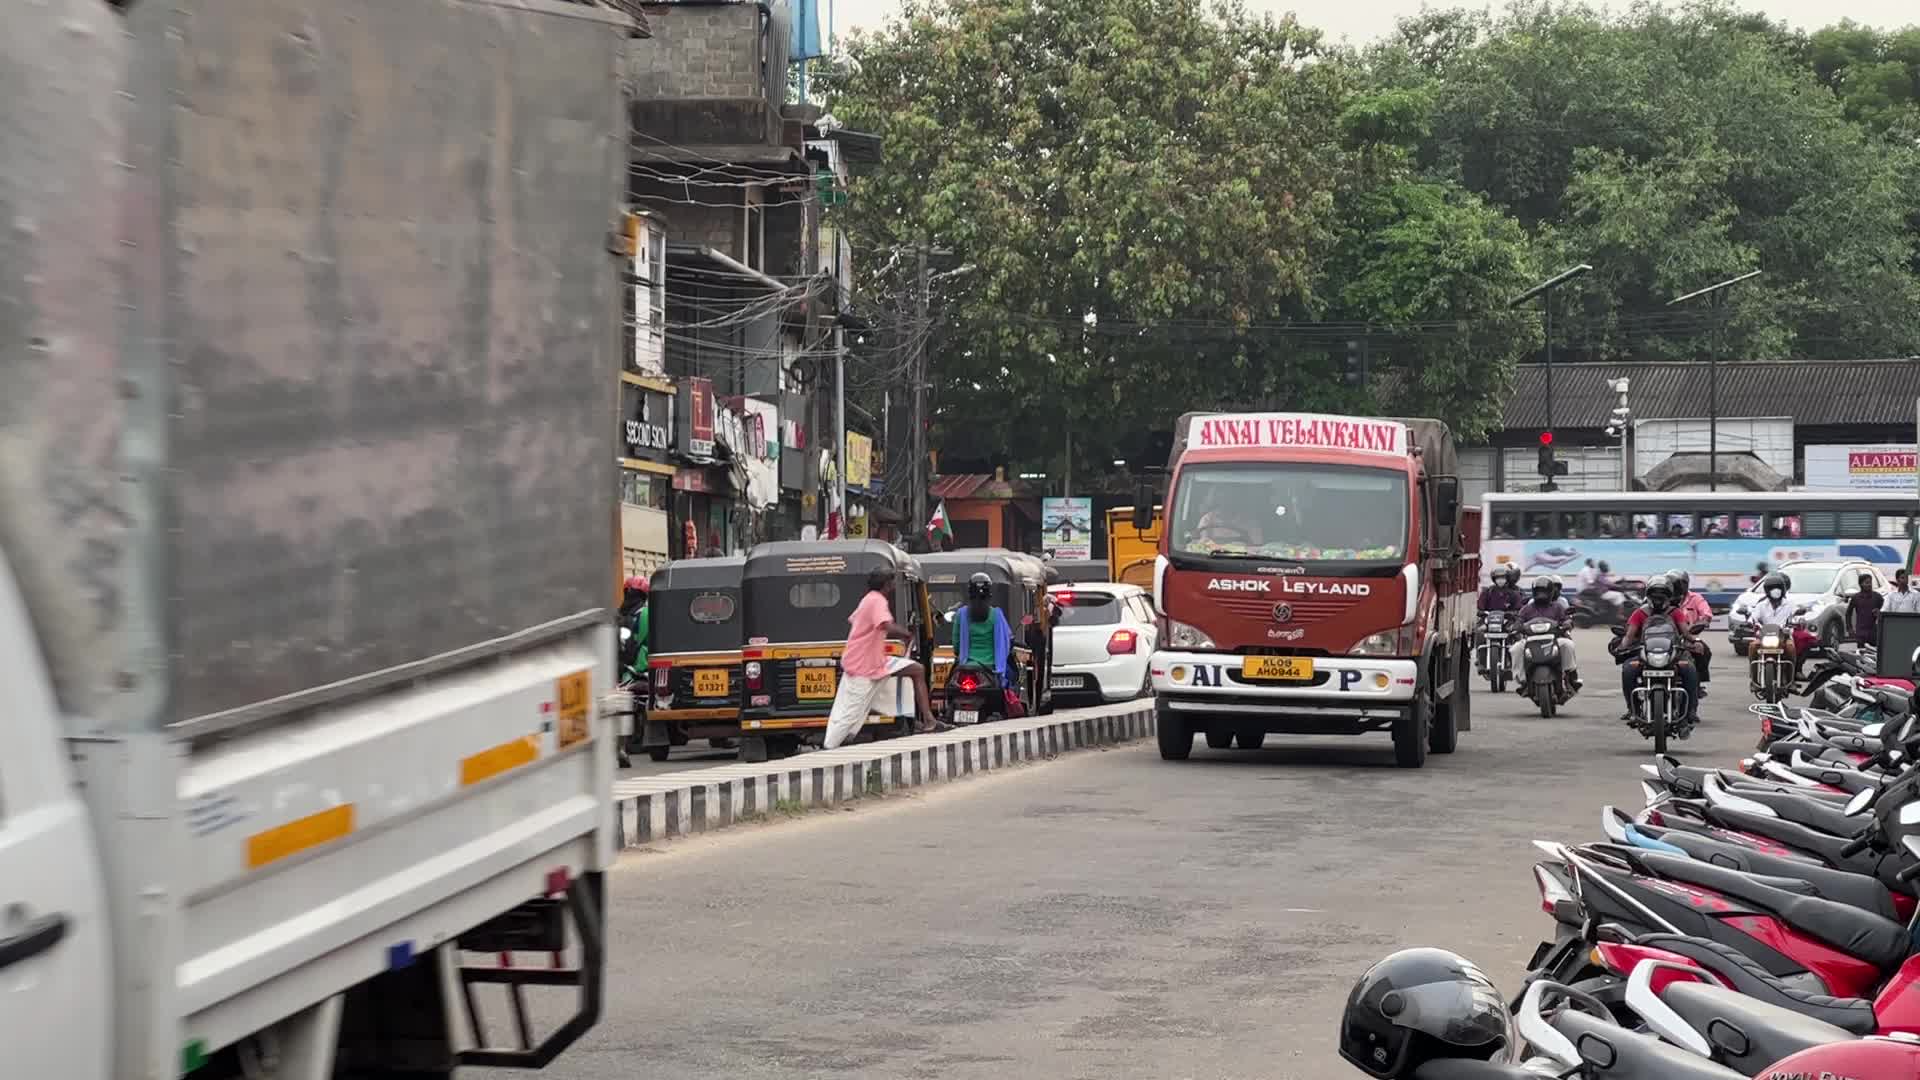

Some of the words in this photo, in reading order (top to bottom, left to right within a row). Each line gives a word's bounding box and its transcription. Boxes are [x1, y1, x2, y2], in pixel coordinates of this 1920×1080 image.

[1201, 419, 1260, 445] ANNAI
[1268, 418, 1397, 452] VELANKANNI
[1207, 578, 1271, 592] ASHOK
[1283, 577, 1370, 595] LEYLAND
[1256, 667, 1301, 676] AH0944
[1263, 658, 1292, 667] KL09
[1192, 665, 1223, 687] AI
[1338, 669, 1362, 691] P
